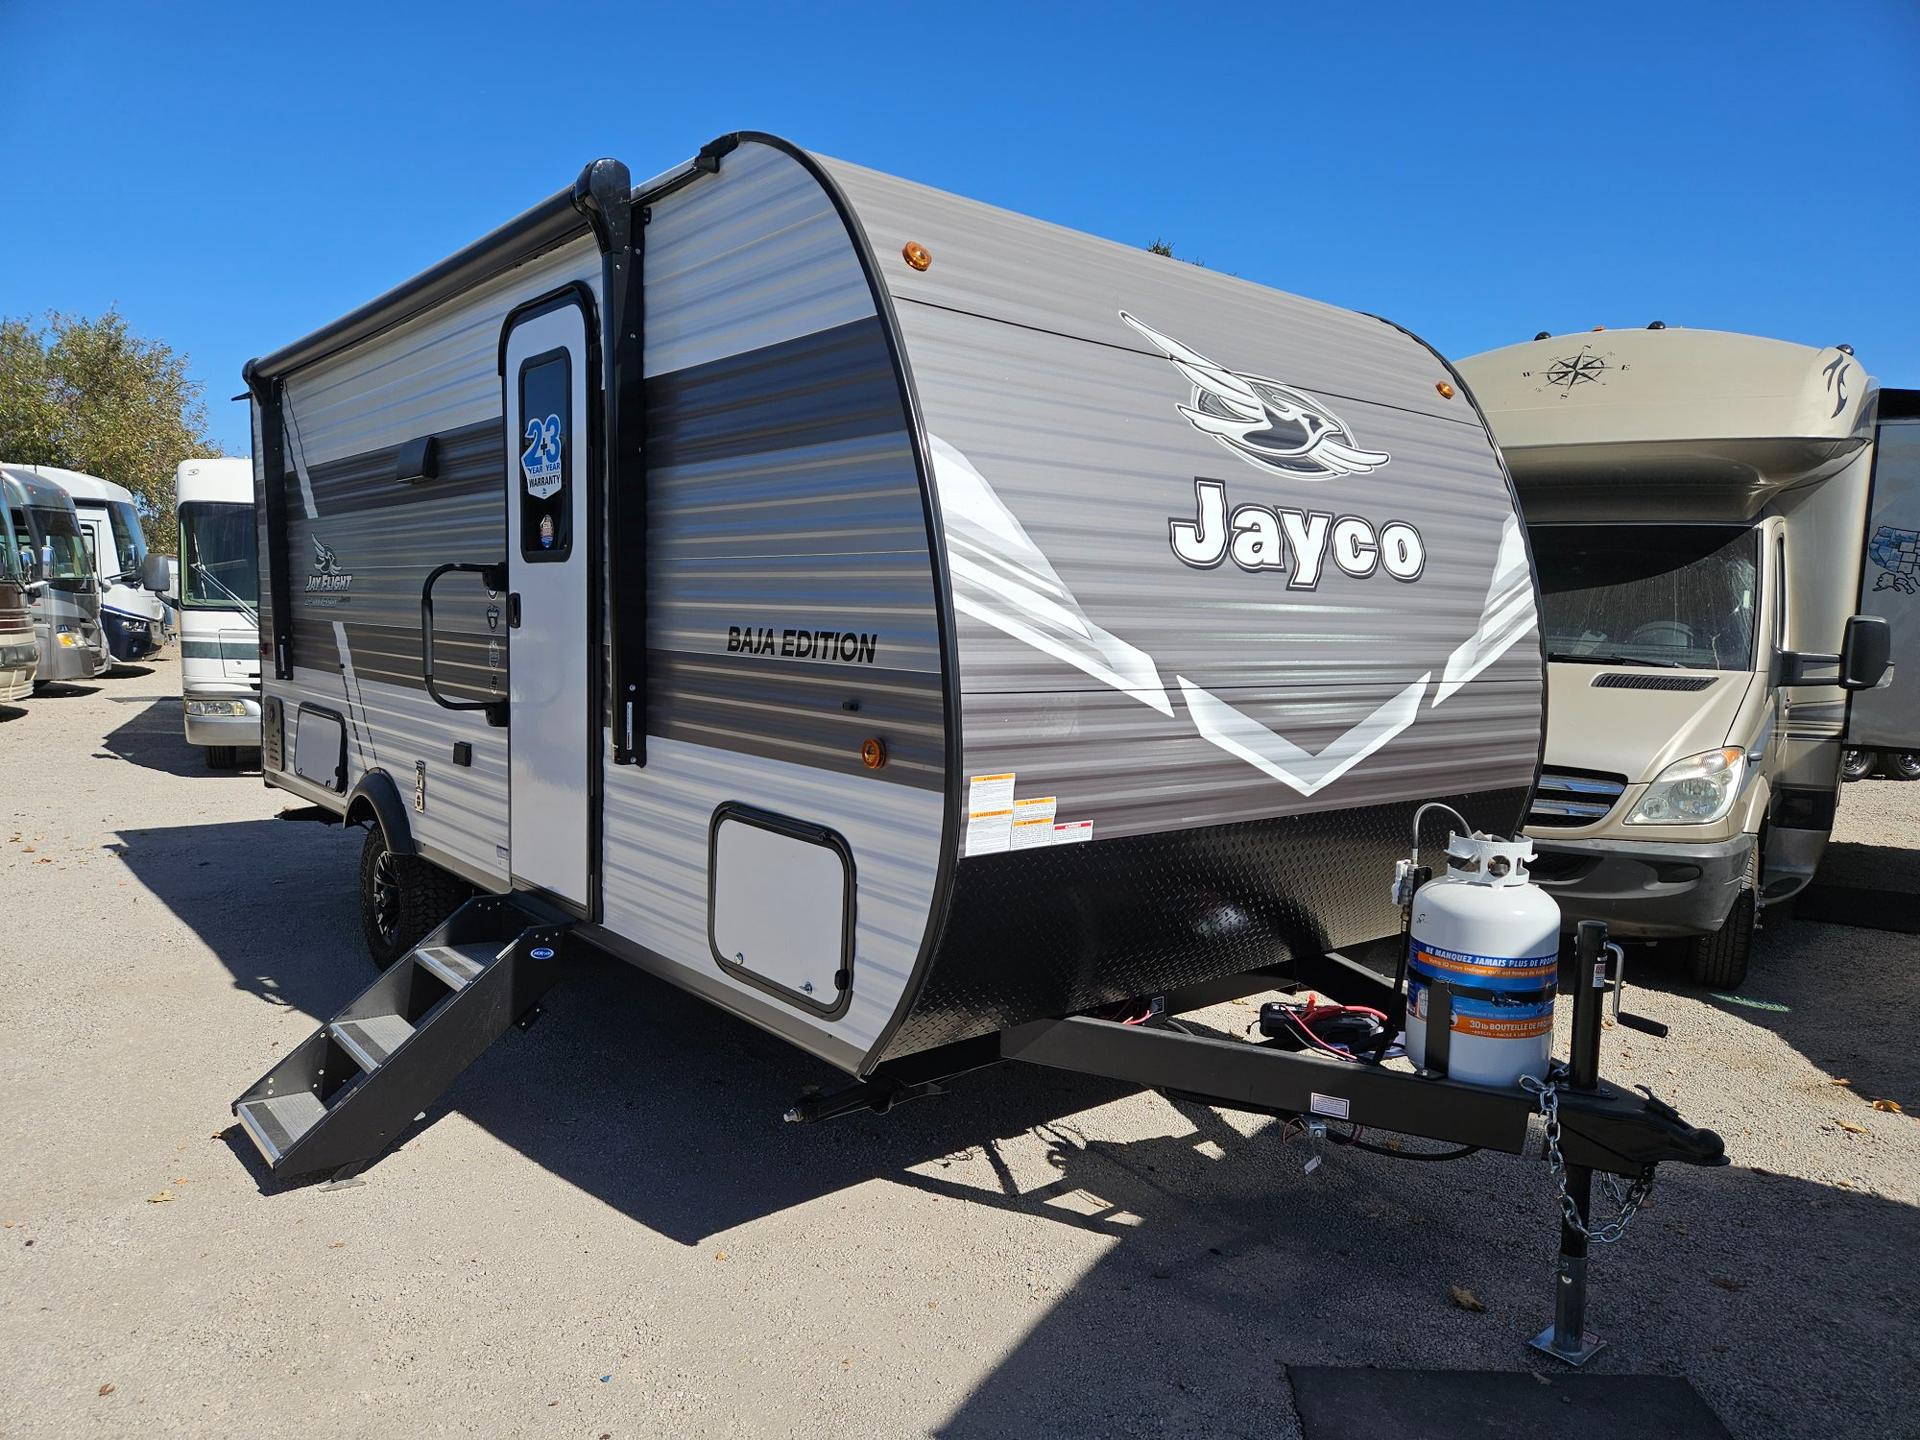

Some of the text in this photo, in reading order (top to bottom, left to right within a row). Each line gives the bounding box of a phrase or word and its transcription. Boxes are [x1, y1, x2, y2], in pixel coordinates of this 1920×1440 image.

[528, 463, 560, 474] YEAR YEAR
[528, 474, 561, 488] WARRANTY
[1168, 476, 1426, 592] Jayco
[727, 626, 878, 664] BAJA EDITION
[1435, 949, 1473, 964] MANQUEZ
[1474, 956, 1507, 967] JAMAIS
[1508, 959, 1529, 967] PLUS
[1529, 959, 1538, 967] DE
[1470, 1020, 1480, 1029] 30
[1489, 1023, 1528, 1031] BOUTEILLE
